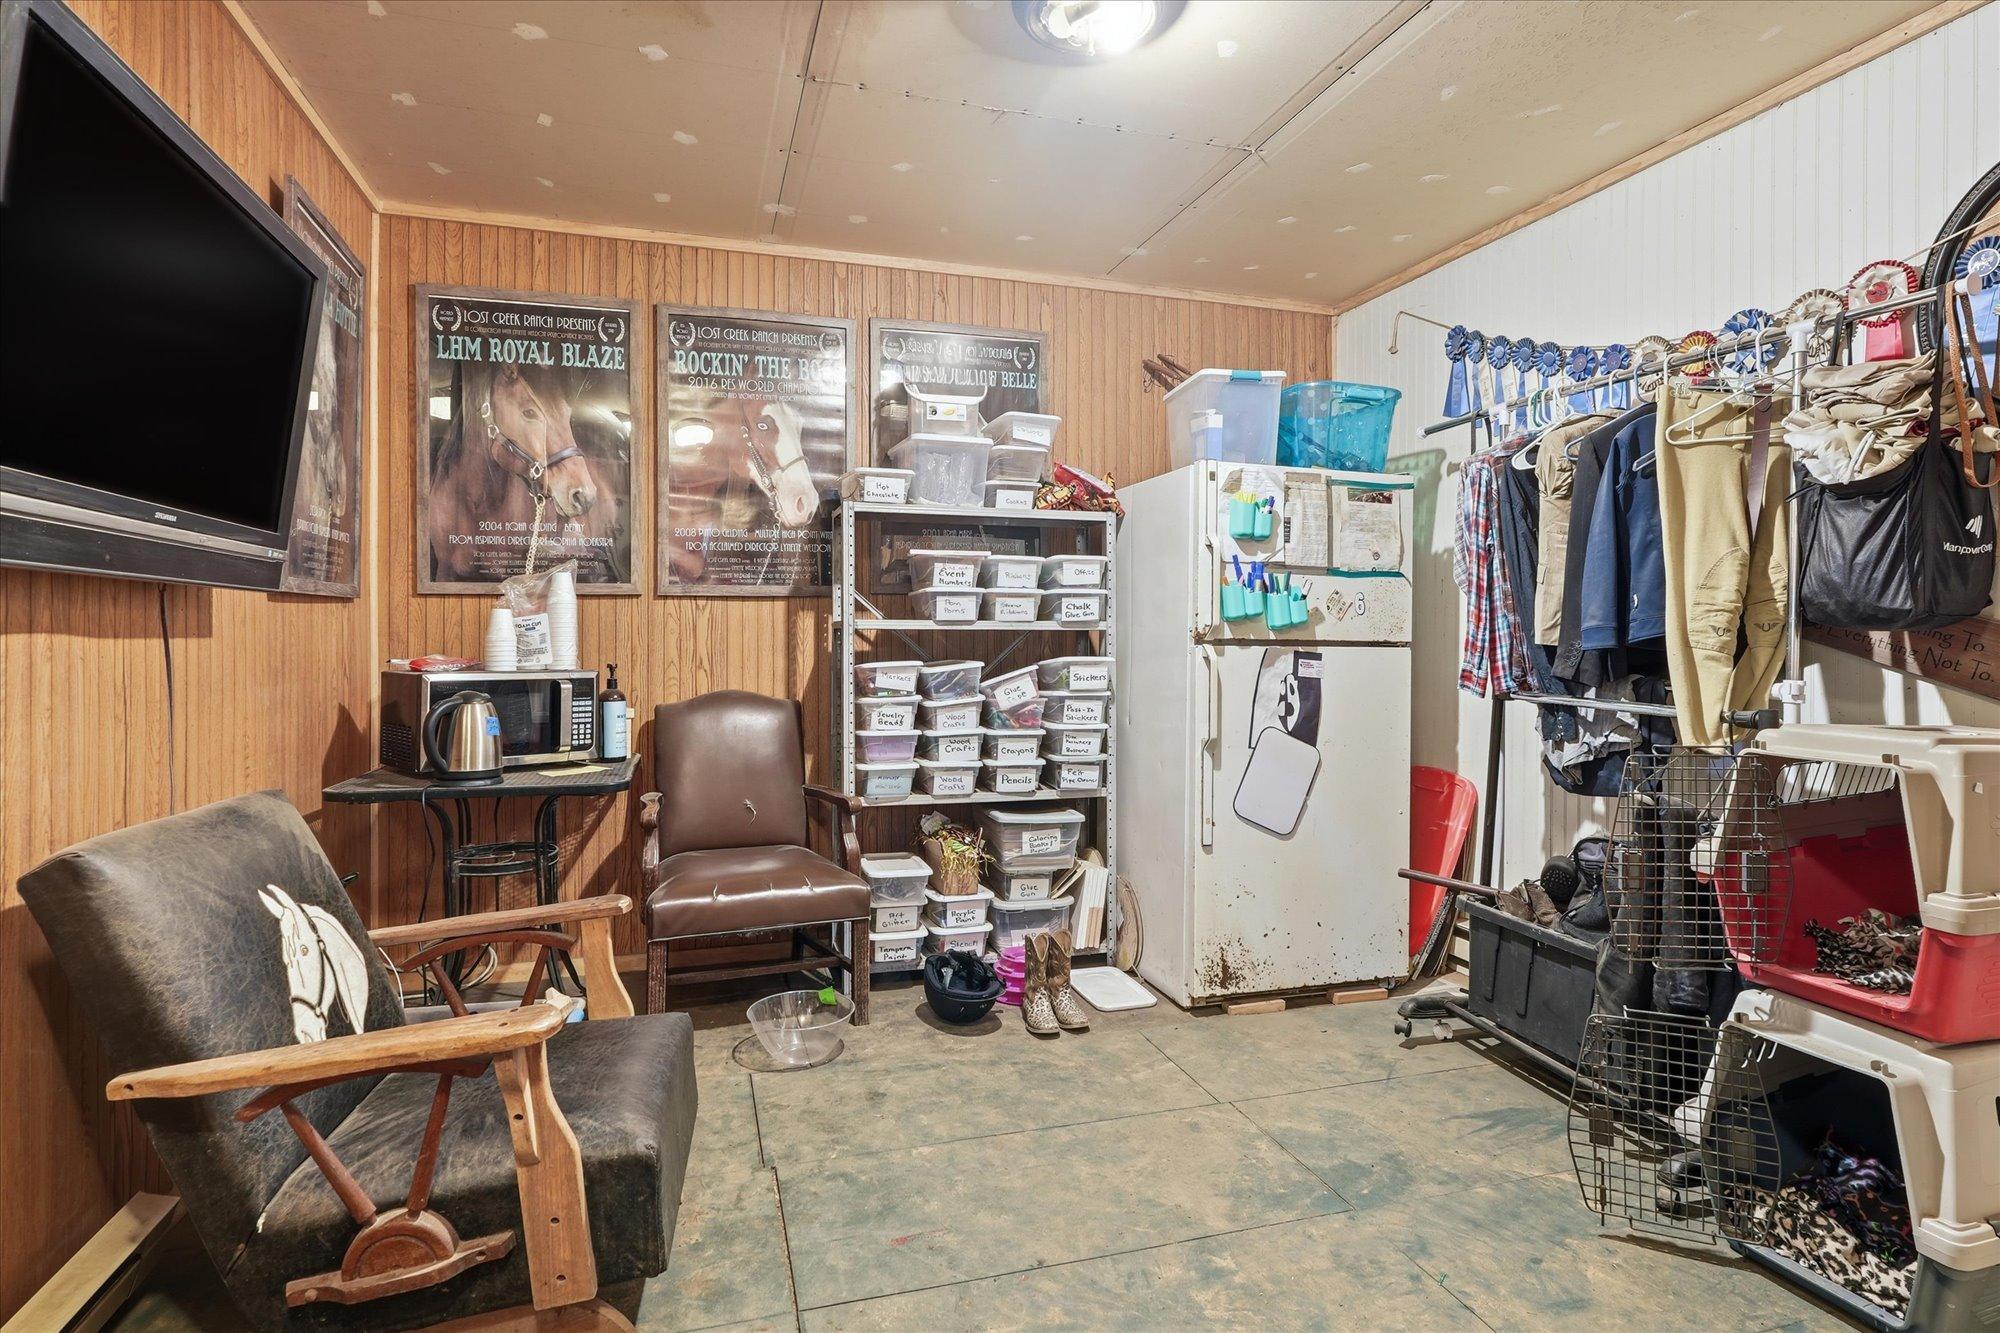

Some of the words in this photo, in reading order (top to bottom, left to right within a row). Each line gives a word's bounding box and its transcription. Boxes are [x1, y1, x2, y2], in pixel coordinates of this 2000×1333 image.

[463, 310, 489, 324] LOST
[492, 312, 520, 326] CREEK
[524, 314, 553, 329] RANCH
[557, 316, 596, 332] PRESENTS
[698, 326, 720, 340] LOST
[724, 328, 749, 342] CREEK
[752, 330, 778, 344] RANCH
[782, 332, 818, 346] PRESENTS
[436, 335, 482, 362] LHM
[488, 338, 554, 366] ROYAL
[561, 342, 625, 370] BLAZE
[674, 349, 748, 377] ROCKIN'
[754, 355, 791, 380] THE
[688, 376, 717, 392] 2016
[721, 378, 736, 390] RES
[738, 379, 774, 393] WORLD
[1001, 372, 1037, 390] BELLE
[876, 482, 890, 491] Hot
[866, 490, 900, 500] Chocolate
[479, 521, 502, 531] 2004
[674, 528, 696, 538] 2008
[722, 528, 748, 538] GELDING
[448, 534, 474, 545] FROM
[685, 542, 708, 551] FROM
[709, 542, 744, 551] ACCLAIMED
[744, 542, 780, 552] DIRECTOR
[938, 567, 966, 578] Event
[939, 578, 972, 587] Numbers
[1066, 602, 1091, 611] Chalk
[1962, 629, 1985, 652] To
[1923, 646, 1960, 672] Not
[1970, 658, 1995, 683] To.
[1073, 672, 1106, 682] Stickers
[1004, 685, 1022, 696] Glue
[877, 712, 905, 720] Jewelry
[944, 745, 976, 753] Crafts
[1001, 747, 1034, 756] Crayons
[1002, 774, 1032, 785] Pencils
[1028, 834, 1058, 842] Coloring
[882, 919, 910, 928] Glitter
